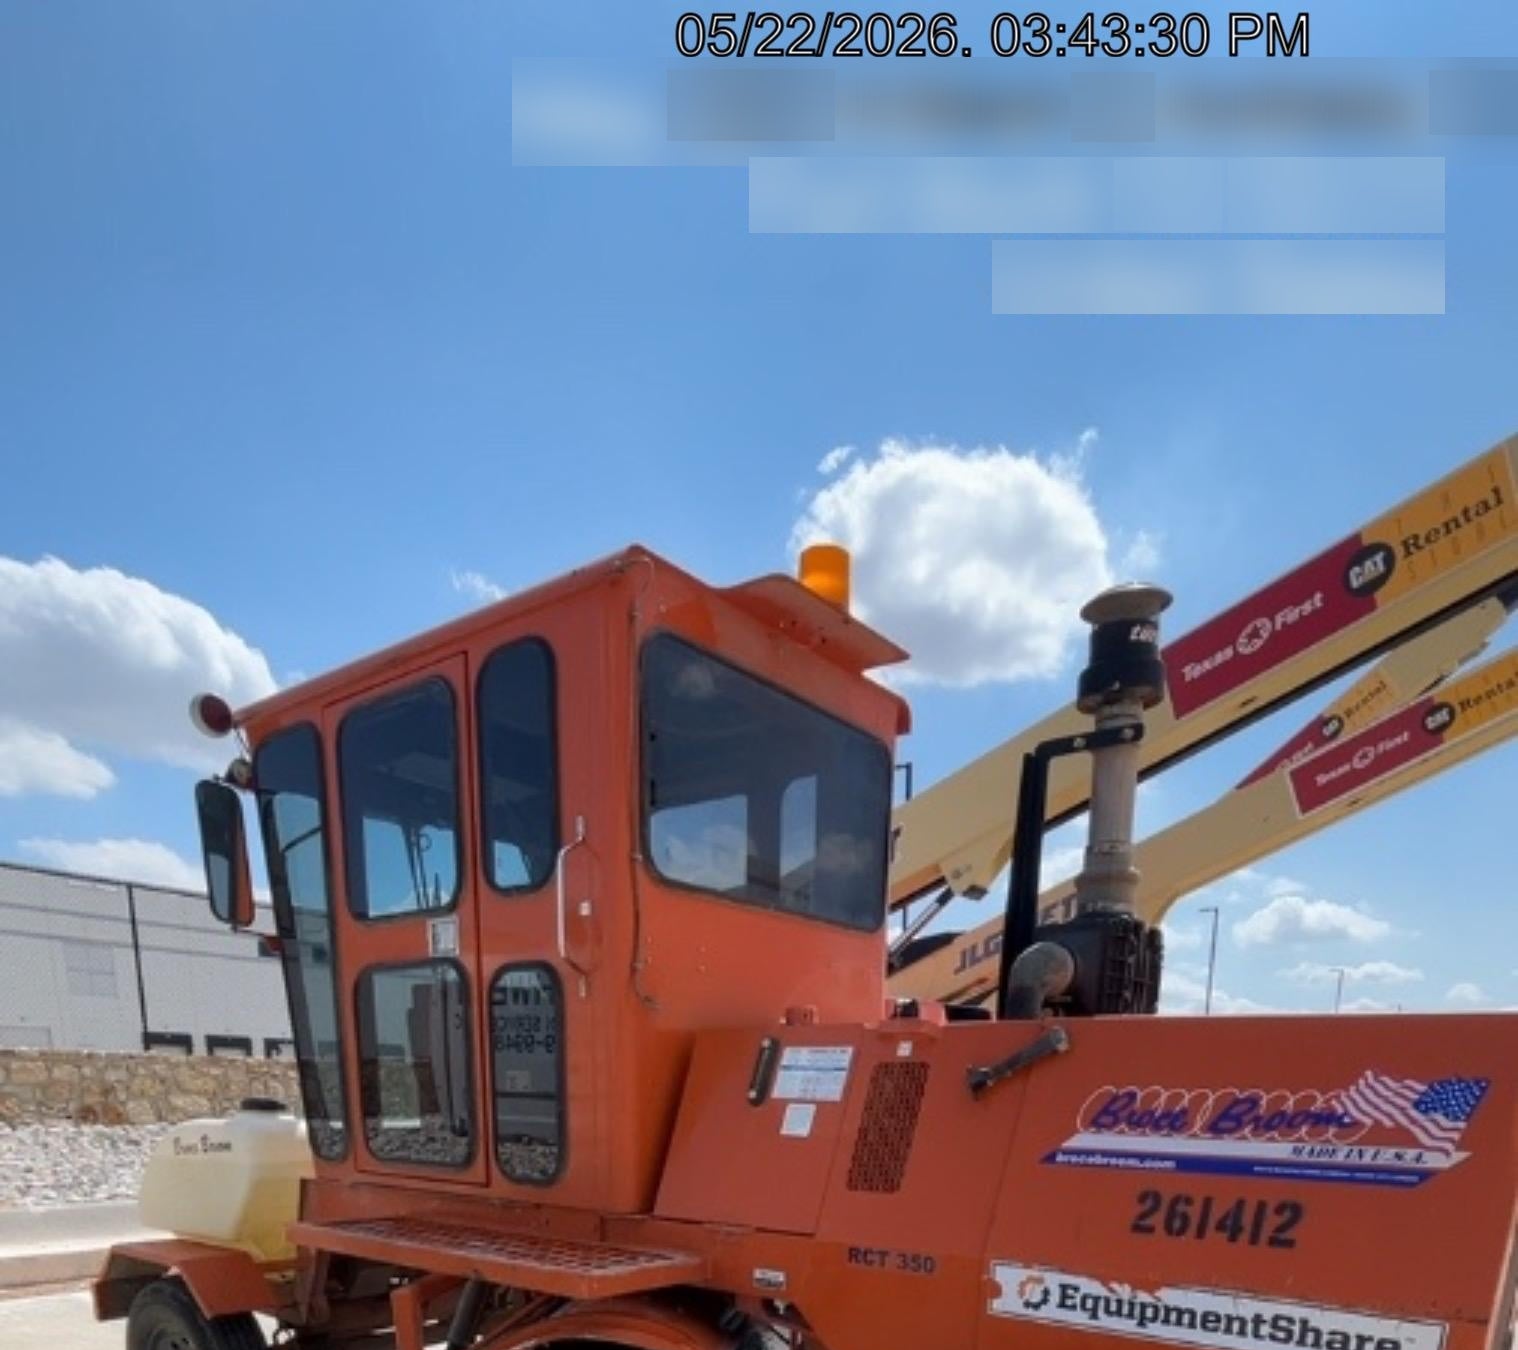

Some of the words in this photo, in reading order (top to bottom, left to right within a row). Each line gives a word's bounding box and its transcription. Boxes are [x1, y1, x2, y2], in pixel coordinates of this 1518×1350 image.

[1181, 645, 1234, 682] Texas
[1273, 591, 1324, 631] First
[1349, 552, 1387, 589] CAT
[1400, 485, 1504, 559] Rental
[1130, 1189, 1304, 1249] 261412
[847, 1246, 889, 1268] RCT
[896, 1252, 937, 1275] 350
